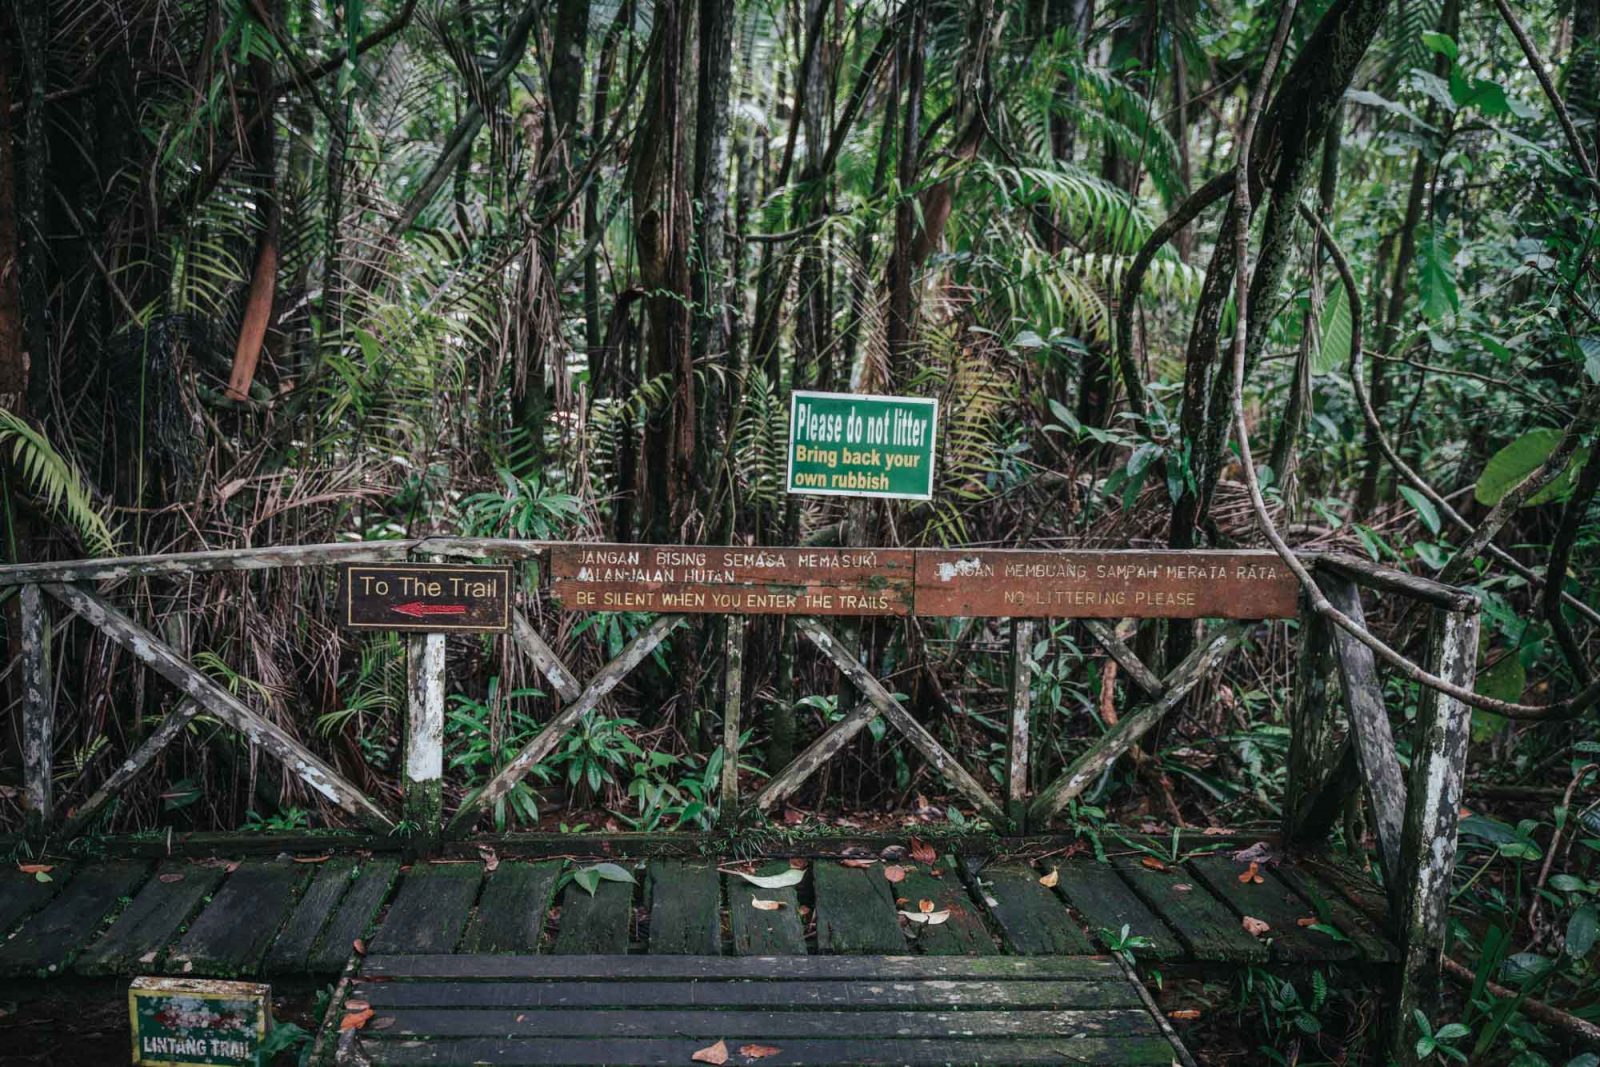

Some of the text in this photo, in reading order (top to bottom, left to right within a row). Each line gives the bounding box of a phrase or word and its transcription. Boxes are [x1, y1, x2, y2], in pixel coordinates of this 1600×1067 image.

[797, 403, 927, 447] Please do not litter
[796, 445, 920, 471] Bring back your
[795, 471, 889, 490] own rubbish
[577, 550, 877, 569] JANGAN BISING SEMASA MEMASUKI
[684, 568, 735, 583] HUTAN
[933, 562, 994, 578] JNGAN
[1005, 563, 1087, 578] MEMBUANG
[1096, 565, 1157, 579] SAMPAH
[360, 576, 497, 598] To The Trail
[576, 591, 596, 605] BE
[603, 592, 655, 606] SILENT
[661, 593, 705, 607] WHEN
[712, 594, 741, 607] YOU
[747, 594, 796, 608] ENTER
[804, 595, 832, 609] THE
[1004, 591, 1196, 606] NO LITTERING PLEASE
[143, 1036, 251, 1060] LINTANG TRAIL
